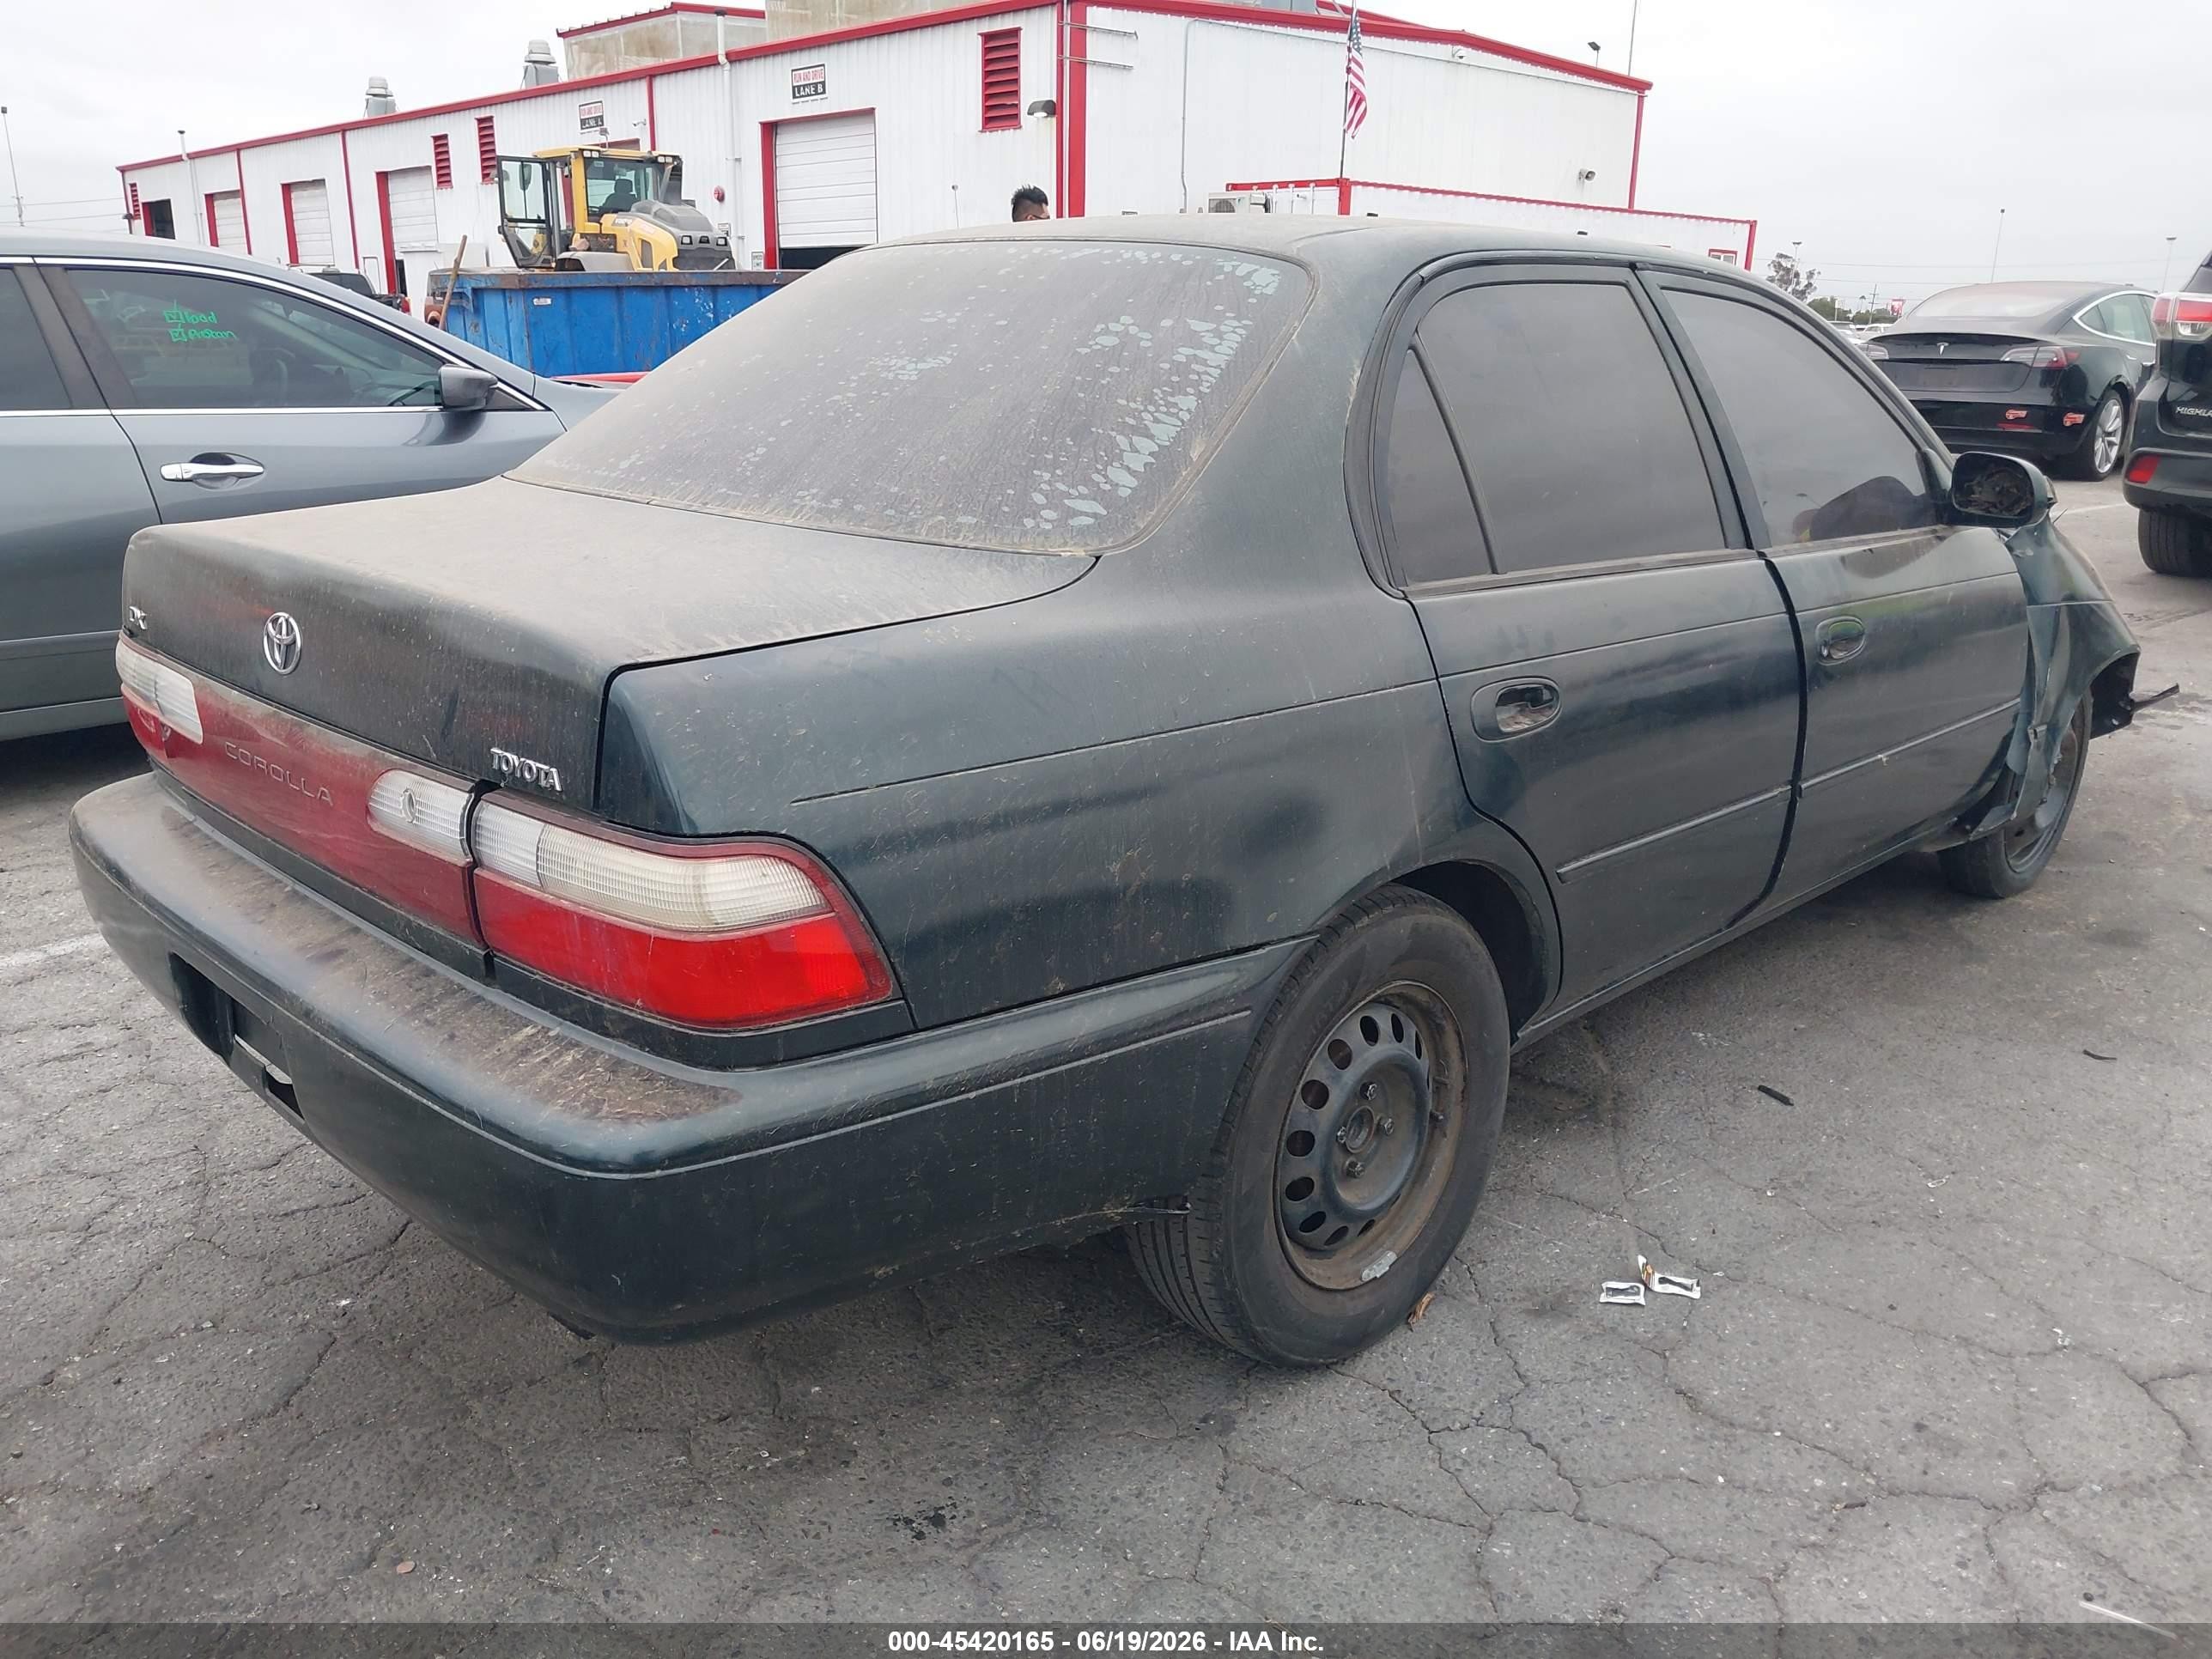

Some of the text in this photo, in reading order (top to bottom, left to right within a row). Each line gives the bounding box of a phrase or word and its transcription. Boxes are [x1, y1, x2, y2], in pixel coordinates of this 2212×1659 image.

[795, 83, 823, 97] LANE B
[129, 605, 148, 629] DX
[225, 741, 333, 807] COROLLA
[490, 747, 562, 791] TOYOTA
